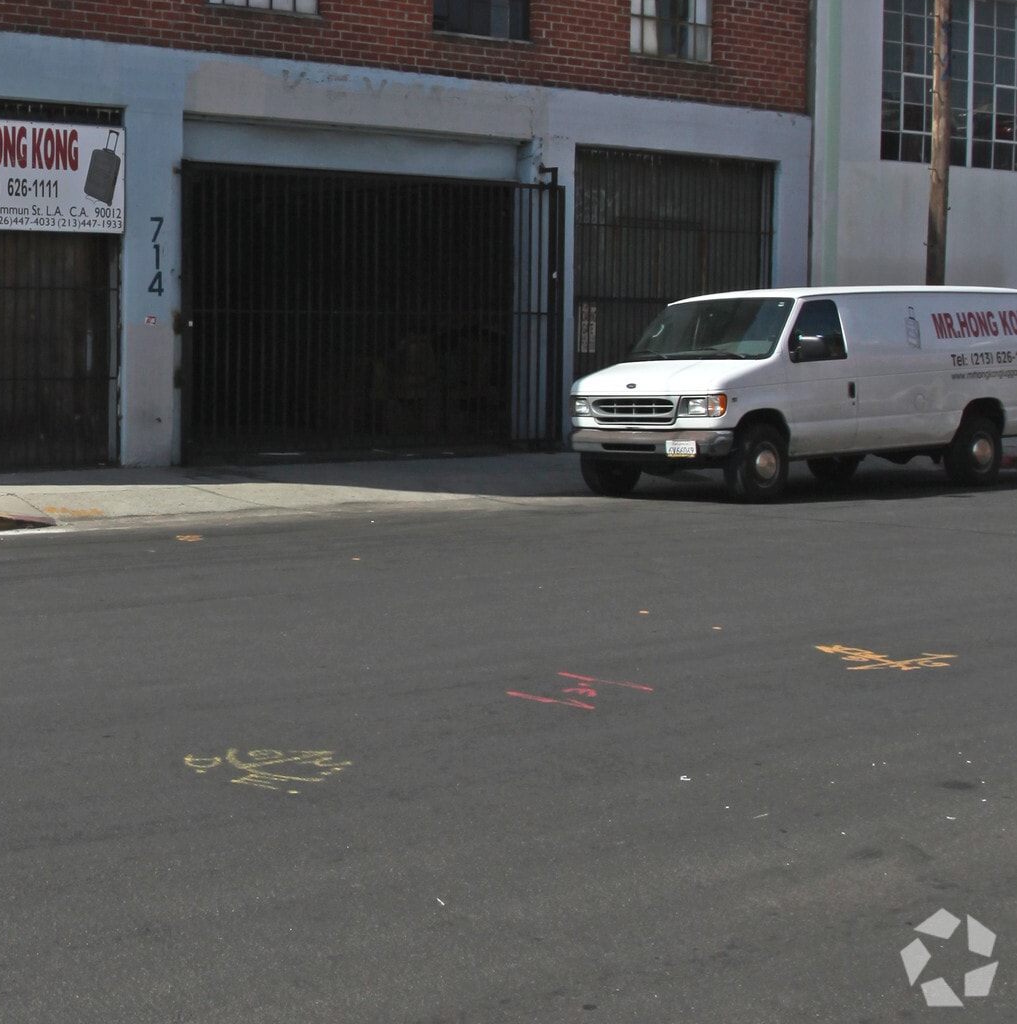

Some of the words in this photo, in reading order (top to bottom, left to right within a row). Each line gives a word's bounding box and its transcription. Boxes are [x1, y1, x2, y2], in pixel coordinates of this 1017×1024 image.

[31, 127, 79, 172] KONG
[7, 178, 59, 198] 626-1111
[31, 204, 44, 217] St.
[94, 207, 122, 219] 90012
[148, 217, 164, 296] 714
[931, 311, 999, 339] MR.HONG
[997, 310, 1017, 337] KO
[951, 353, 968, 367] Tel:
[970, 351, 994, 366] (213)
